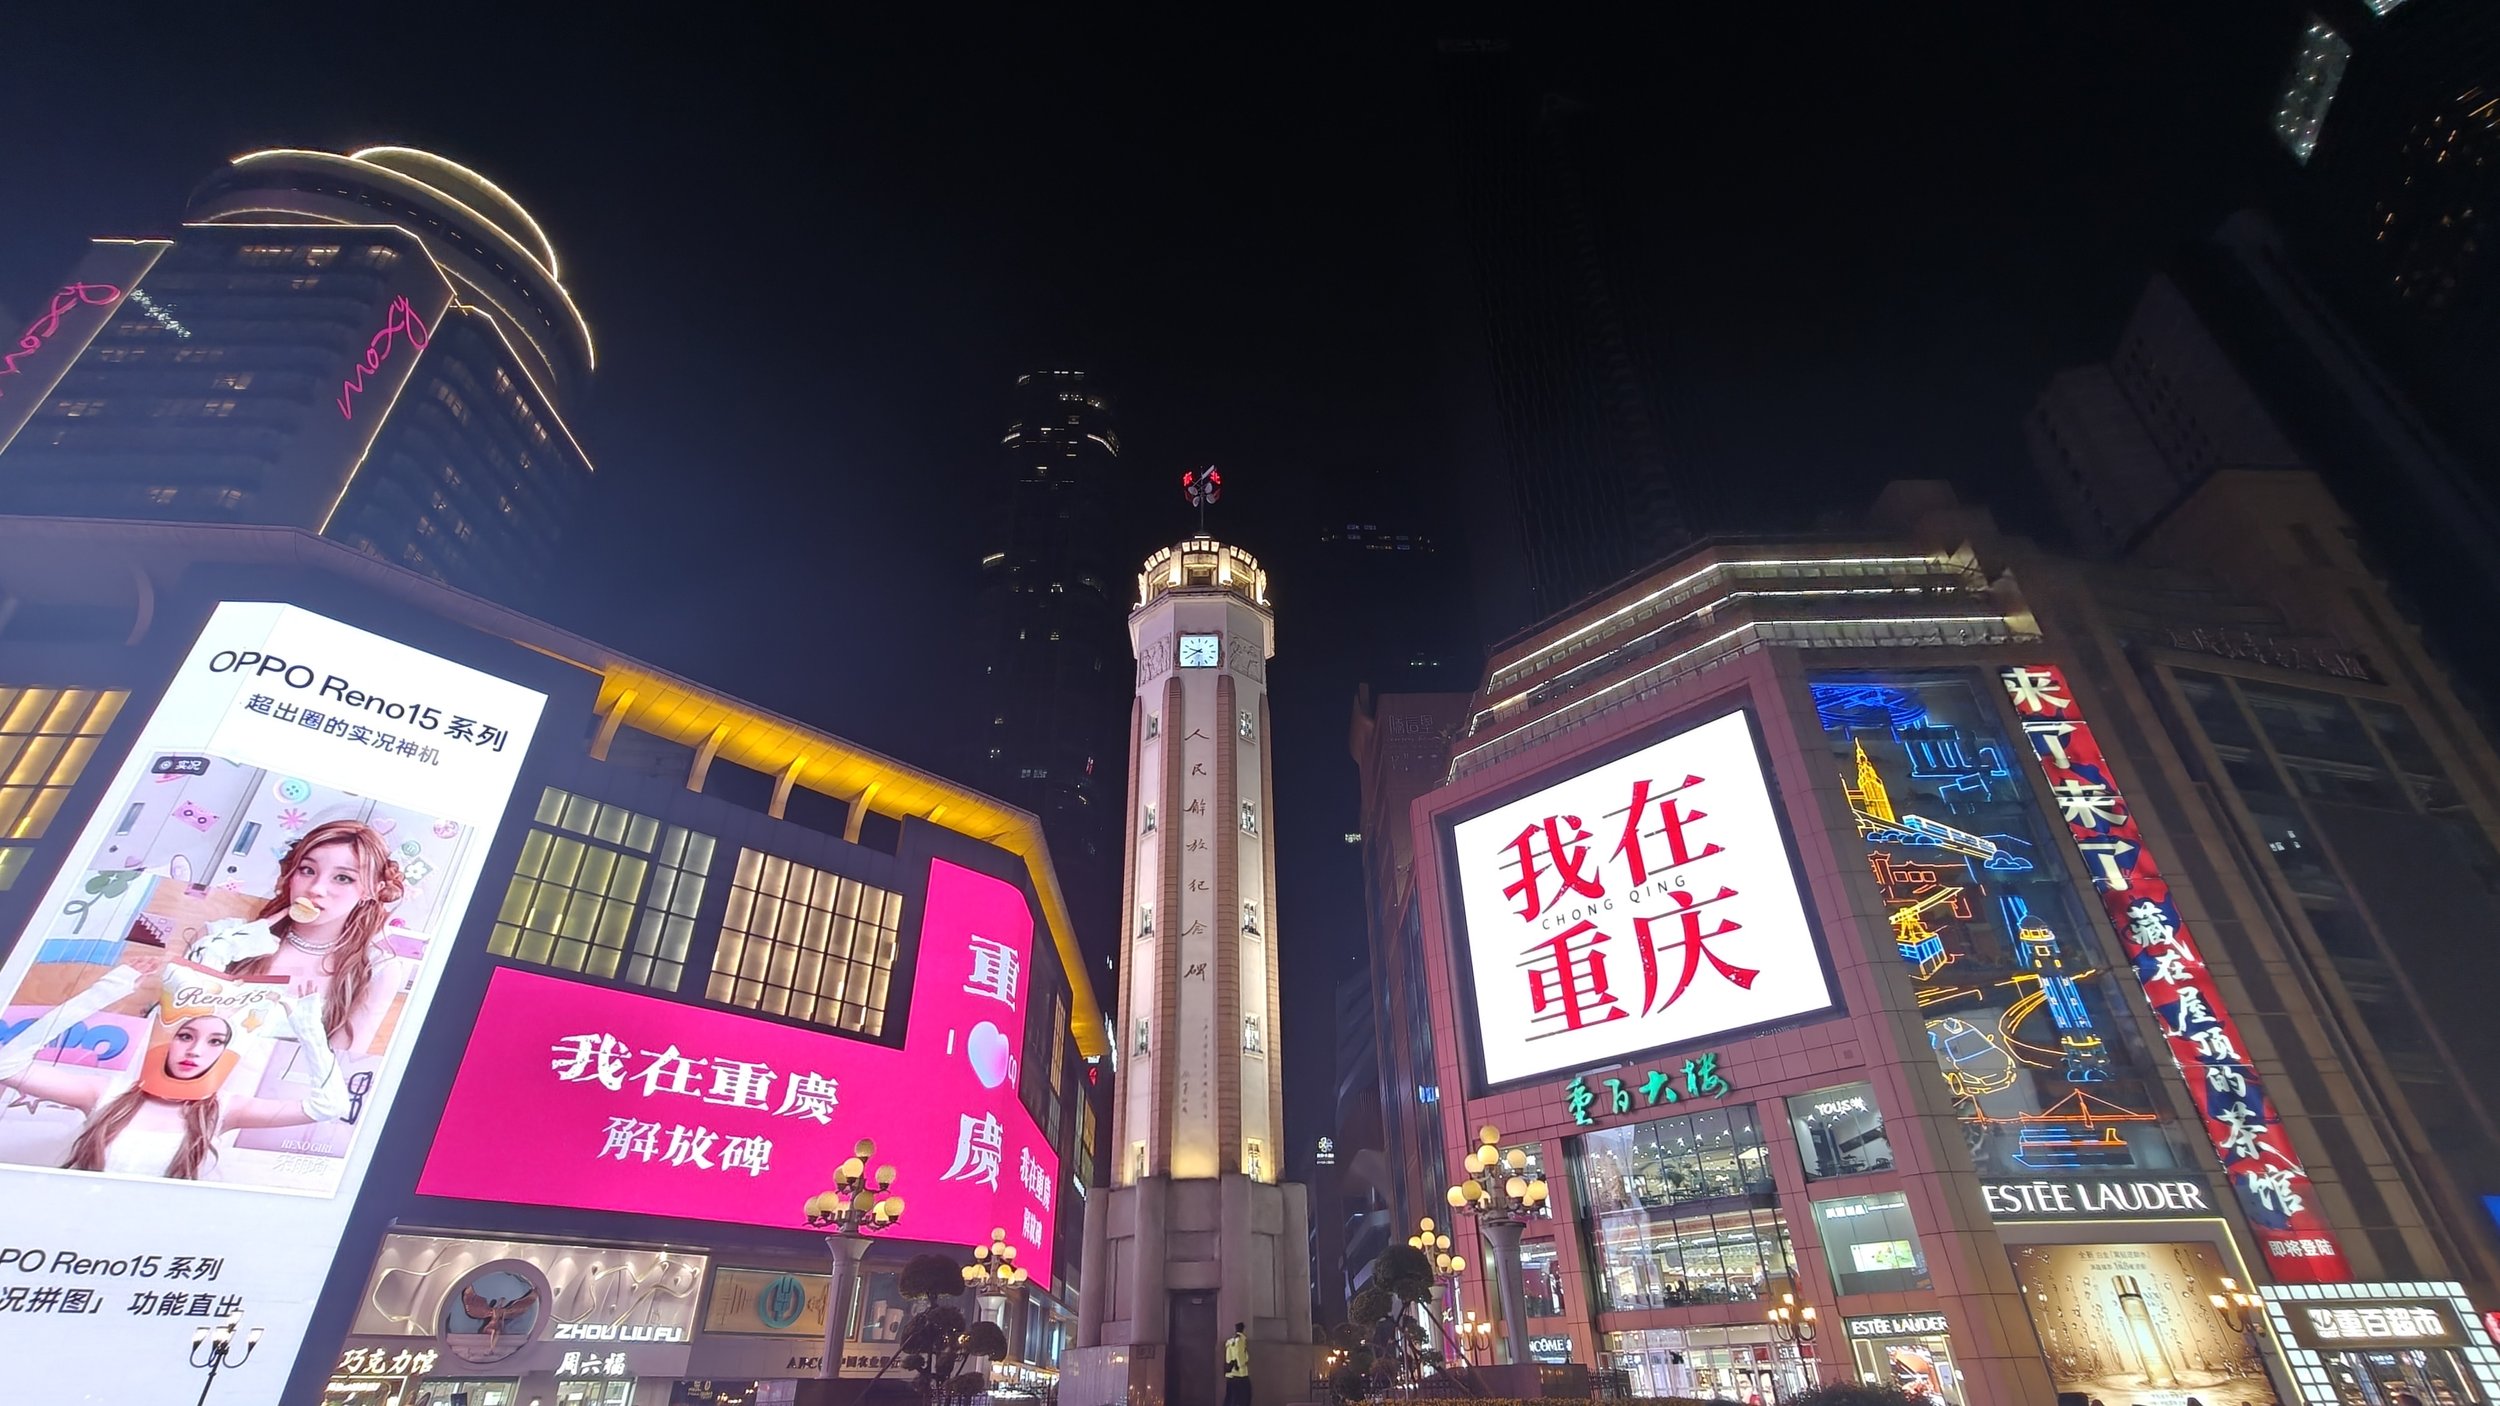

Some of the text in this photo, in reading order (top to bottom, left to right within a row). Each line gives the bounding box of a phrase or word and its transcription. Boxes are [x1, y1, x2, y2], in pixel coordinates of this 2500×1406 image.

[208, 650, 509, 753] OPPO Reno15 系列
[244, 692, 441, 767] 超出圈的实况神机
[1497, 773, 1726, 924] 我在
[1541, 874, 1688, 931] CHONG QING
[963, 934, 1020, 1012] 重
[1516, 885, 1761, 1042] 重庆
[551, 1032, 840, 1126] 我在重慶
[597, 1116, 774, 1177] 解放碑
[940, 1111, 1004, 1193] 慶
[2080, 1182, 2209, 1212] LAUDER
[50, 1251, 162, 1278] Reno15
[164, 1256, 225, 1282] 系列
[2267, 1239, 2334, 1258] 即将登陆
[127, 1290, 245, 1318] 功能直出
[2332, 1307, 2446, 1337] 重百超市
[338, 1348, 439, 1375] 巧克力馆
[554, 1323, 683, 1343] ZHOU LIU FU
[554, 1351, 626, 1377] 周六福
